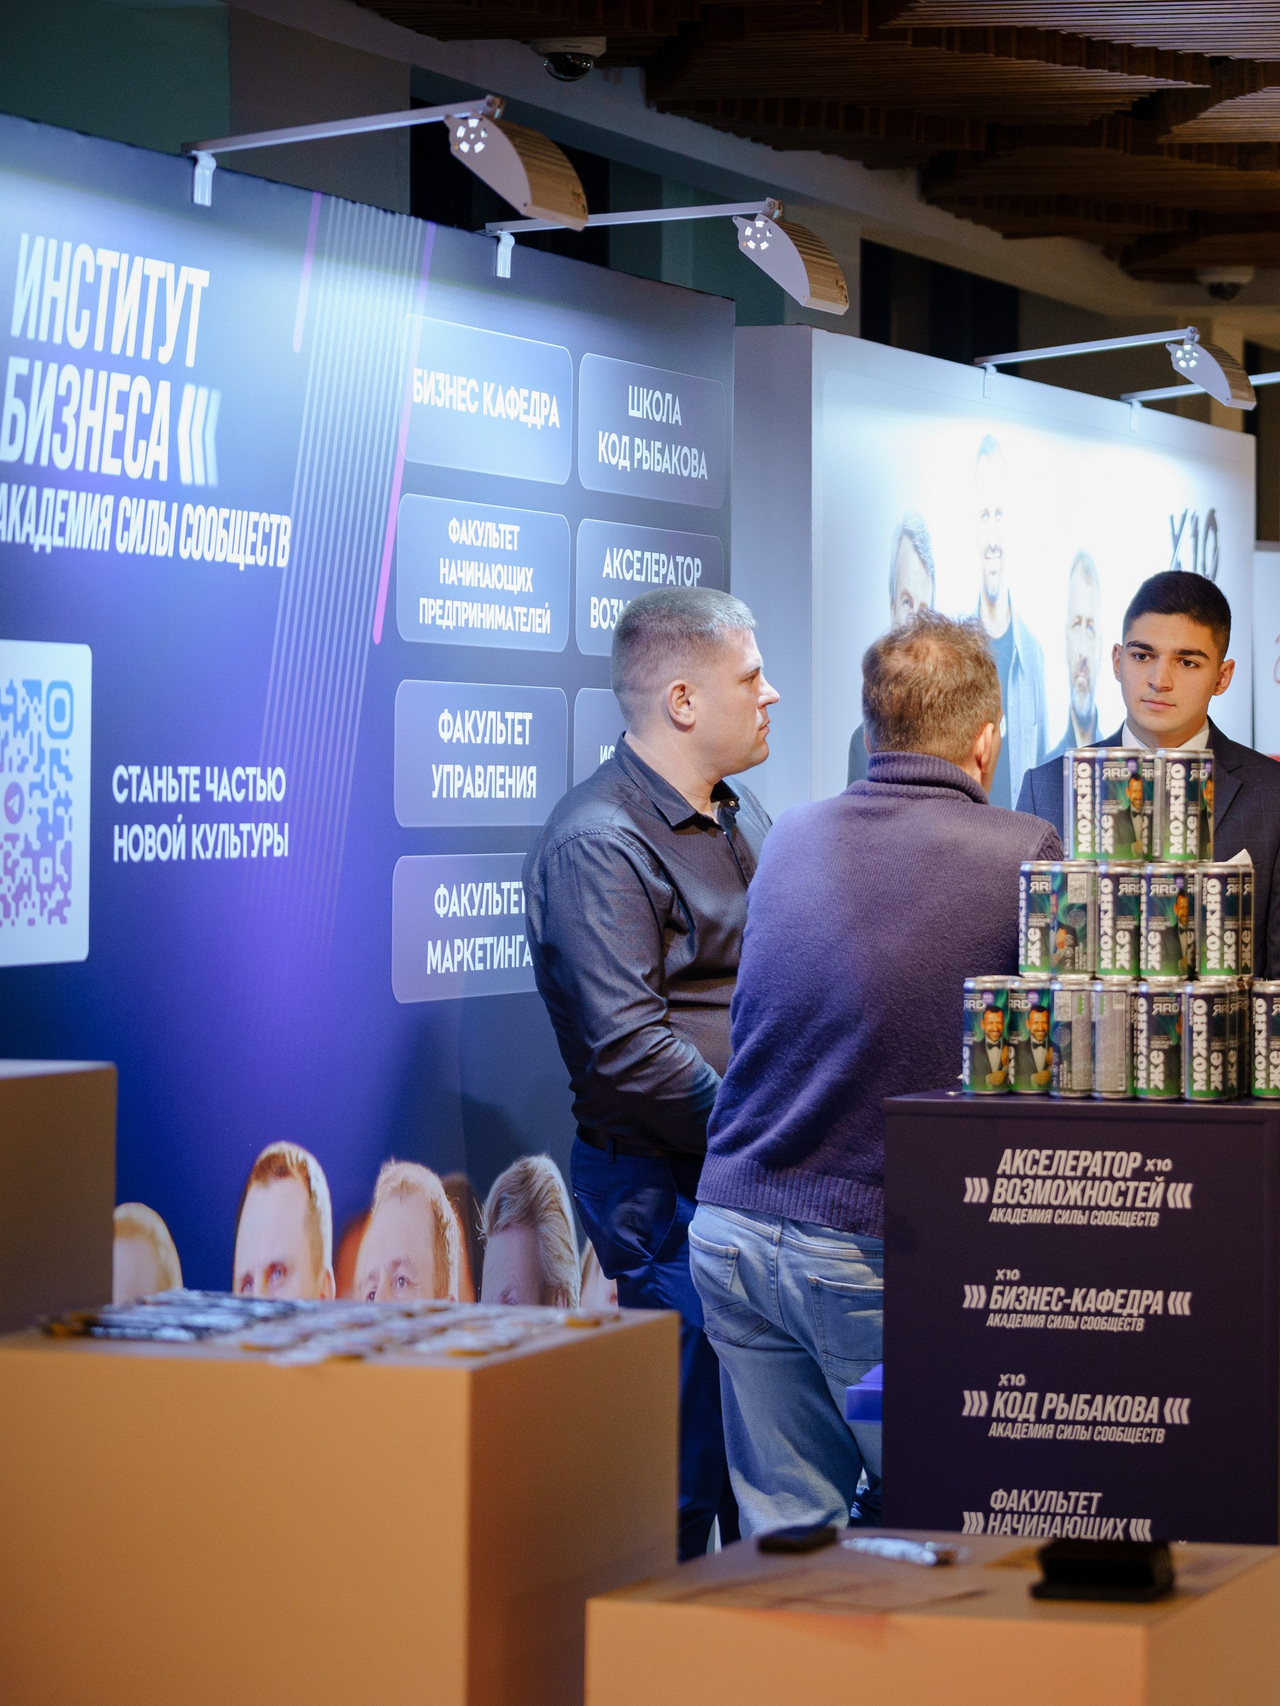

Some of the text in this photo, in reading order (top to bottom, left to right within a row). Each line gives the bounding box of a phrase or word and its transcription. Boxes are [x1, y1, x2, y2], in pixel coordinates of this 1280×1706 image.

[11, 233, 210, 367] ИНСТИТУТ
[412, 368, 560, 430] БИЗНЕС КАФЕДРА
[628, 384, 682, 426] ШКОЛА
[0, 355, 171, 481] БИЗНЕСА
[598, 431, 708, 480] КОД РЫБАКОВА
[0, 483, 292, 571] АКАДЕМИЯ СИЛЫ СООБЩЕСТВ
[448, 517, 520, 551] ФАКУЛЬТЕТ
[439, 558, 534, 595] НАЧИНАЮЩИХ
[602, 547, 702, 587] АКСЕЛЕРАТОР
[419, 597, 551, 634] ПРЕДПРИНИМАТЕЛЕЙ
[438, 708, 533, 745] ФАКУЛЬТЕТ
[112, 764, 286, 803] СТАНЬТЕ ЧАСТЬЮ
[431, 764, 536, 799] УПРАВЛЕНИЯ
[113, 813, 289, 863] НОВОЙ КУЛЬТУРЫ
[434, 881, 526, 918] ФАКУЛЬТЕТ
[427, 935, 534, 975] МАРКЕТИНГА
[997, 1148, 1143, 1178] АКСЕЛЕРАТОР
[991, 1176, 1165, 1209] ВОЗМОЖНОСТЕЙ
[988, 1207, 1160, 1228] АКАДЕМИЯ СИЛЫ СООБЩЕСТВ
[988, 1285, 1165, 1317] БИЗНЕС-КАФЕДРА
[986, 1313, 1145, 1333] АКАДЕМИЯ СИЛЫ СООБЩЕСТВ
[991, 1391, 1159, 1424] КОД РЫБАКОВА
[988, 1422, 1166, 1444] АКАДЕМИЯ СИЛЫ СООБЩЕСТВ
[990, 1489, 1103, 1515] ФАКУЛЬТЕТ
[987, 1513, 1128, 1542] НАЧИНАЮЩИХ
